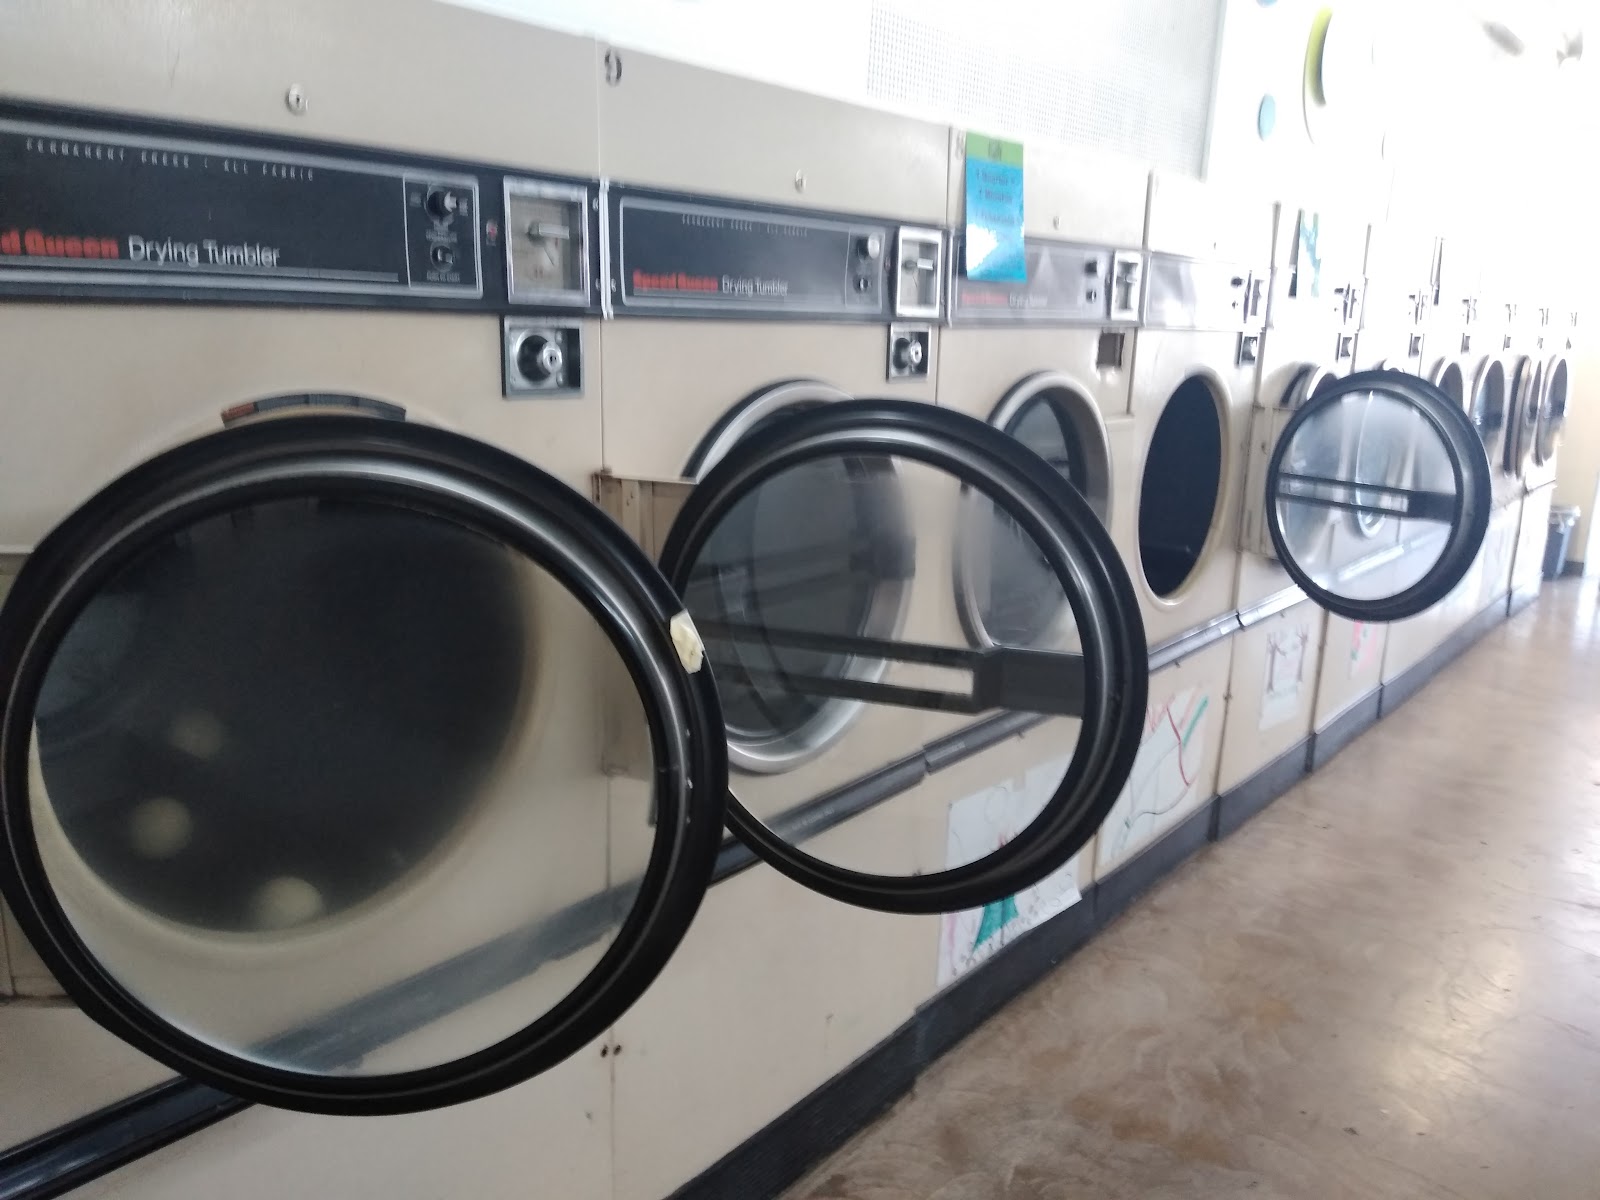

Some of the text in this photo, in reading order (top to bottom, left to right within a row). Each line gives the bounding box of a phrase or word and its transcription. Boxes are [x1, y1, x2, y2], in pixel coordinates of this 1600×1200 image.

[24, 228, 119, 259] Queen
[128, 235, 200, 268] Drying
[203, 238, 281, 268] Tumbler
[722, 274, 754, 298] Drying
[754, 276, 789, 297] Tumbler
